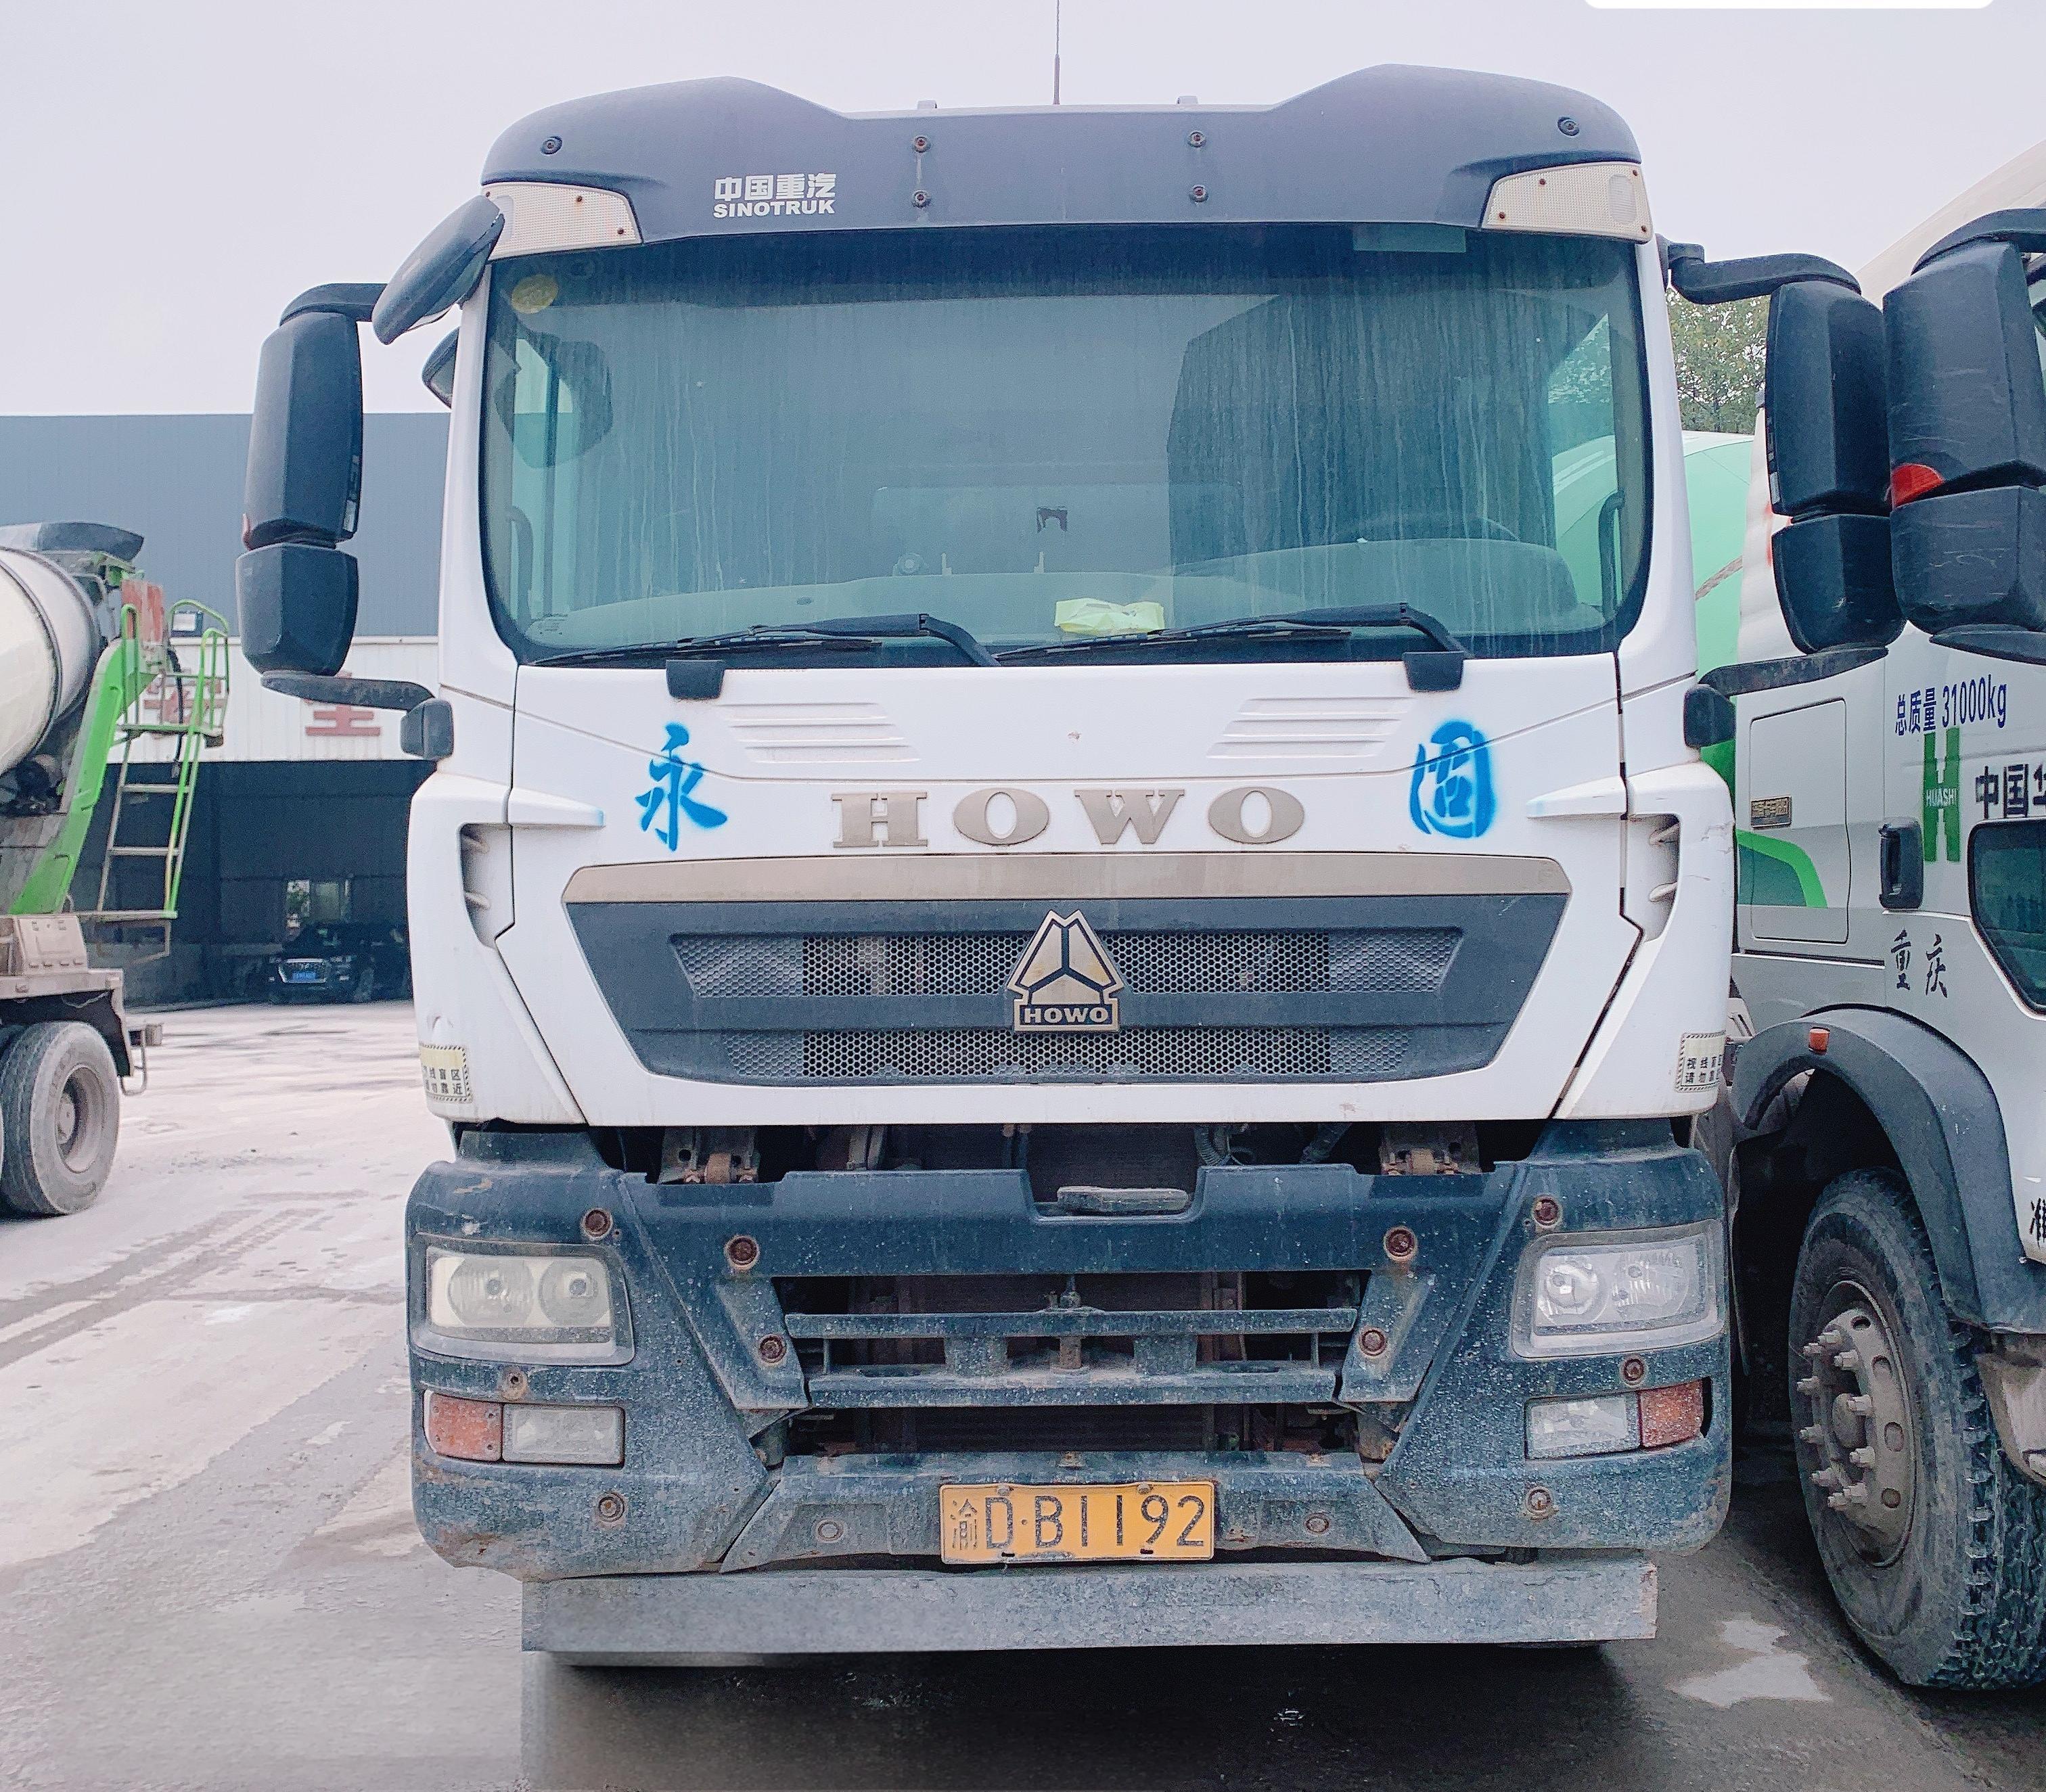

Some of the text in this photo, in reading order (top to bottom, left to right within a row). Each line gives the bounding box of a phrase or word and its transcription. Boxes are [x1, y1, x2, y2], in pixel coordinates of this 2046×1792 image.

[714, 173, 836, 201] 中国重汽
[713, 200, 836, 219] SINOTRUK
[1895, 674, 2007, 736] 总质量 31000kg
[635, 721, 728, 852] 永
[1926, 787, 1958, 807] HUASHI
[831, 787, 1305, 848] HOWO
[1890, 929, 1948, 998] 重庆
[1024, 1007, 1108, 1024] HOWO
